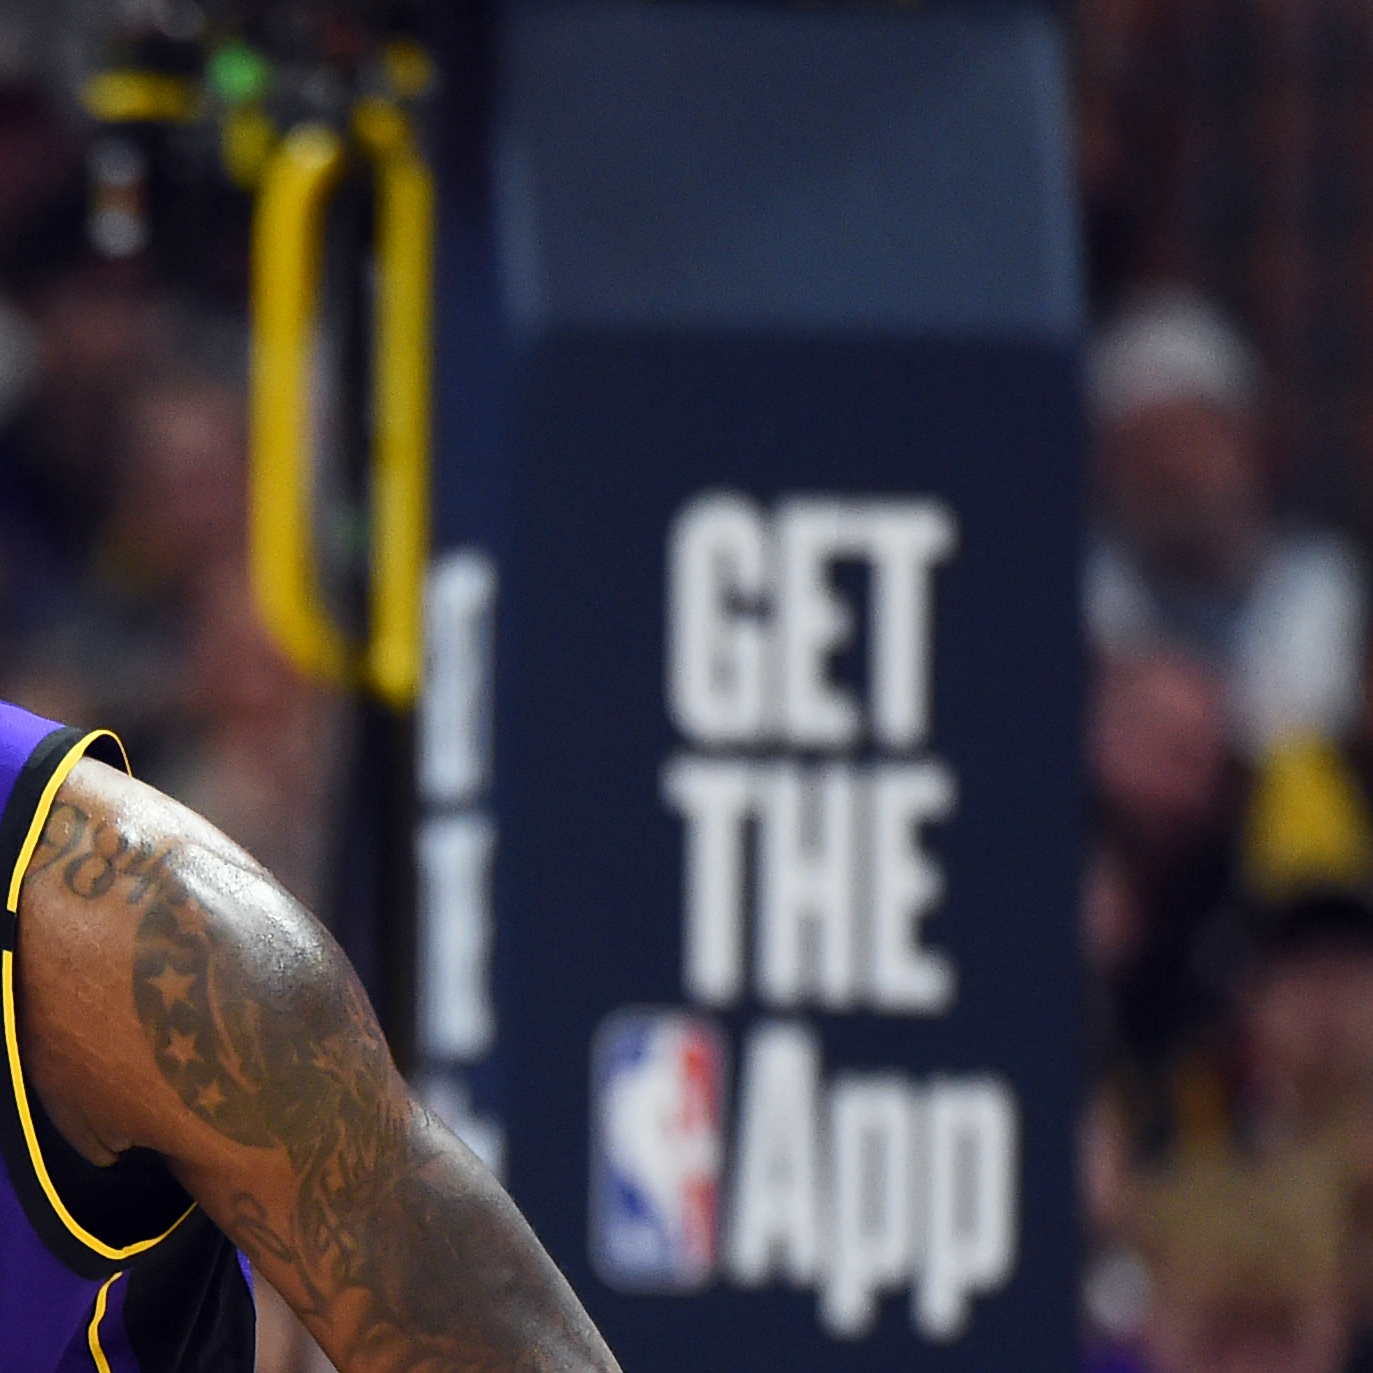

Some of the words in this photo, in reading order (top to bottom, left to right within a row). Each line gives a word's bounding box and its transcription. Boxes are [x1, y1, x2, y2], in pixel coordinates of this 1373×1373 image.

[666, 490, 957, 748] GET
[661, 758, 958, 1013] THE
[727, 1022, 1019, 1338] App
